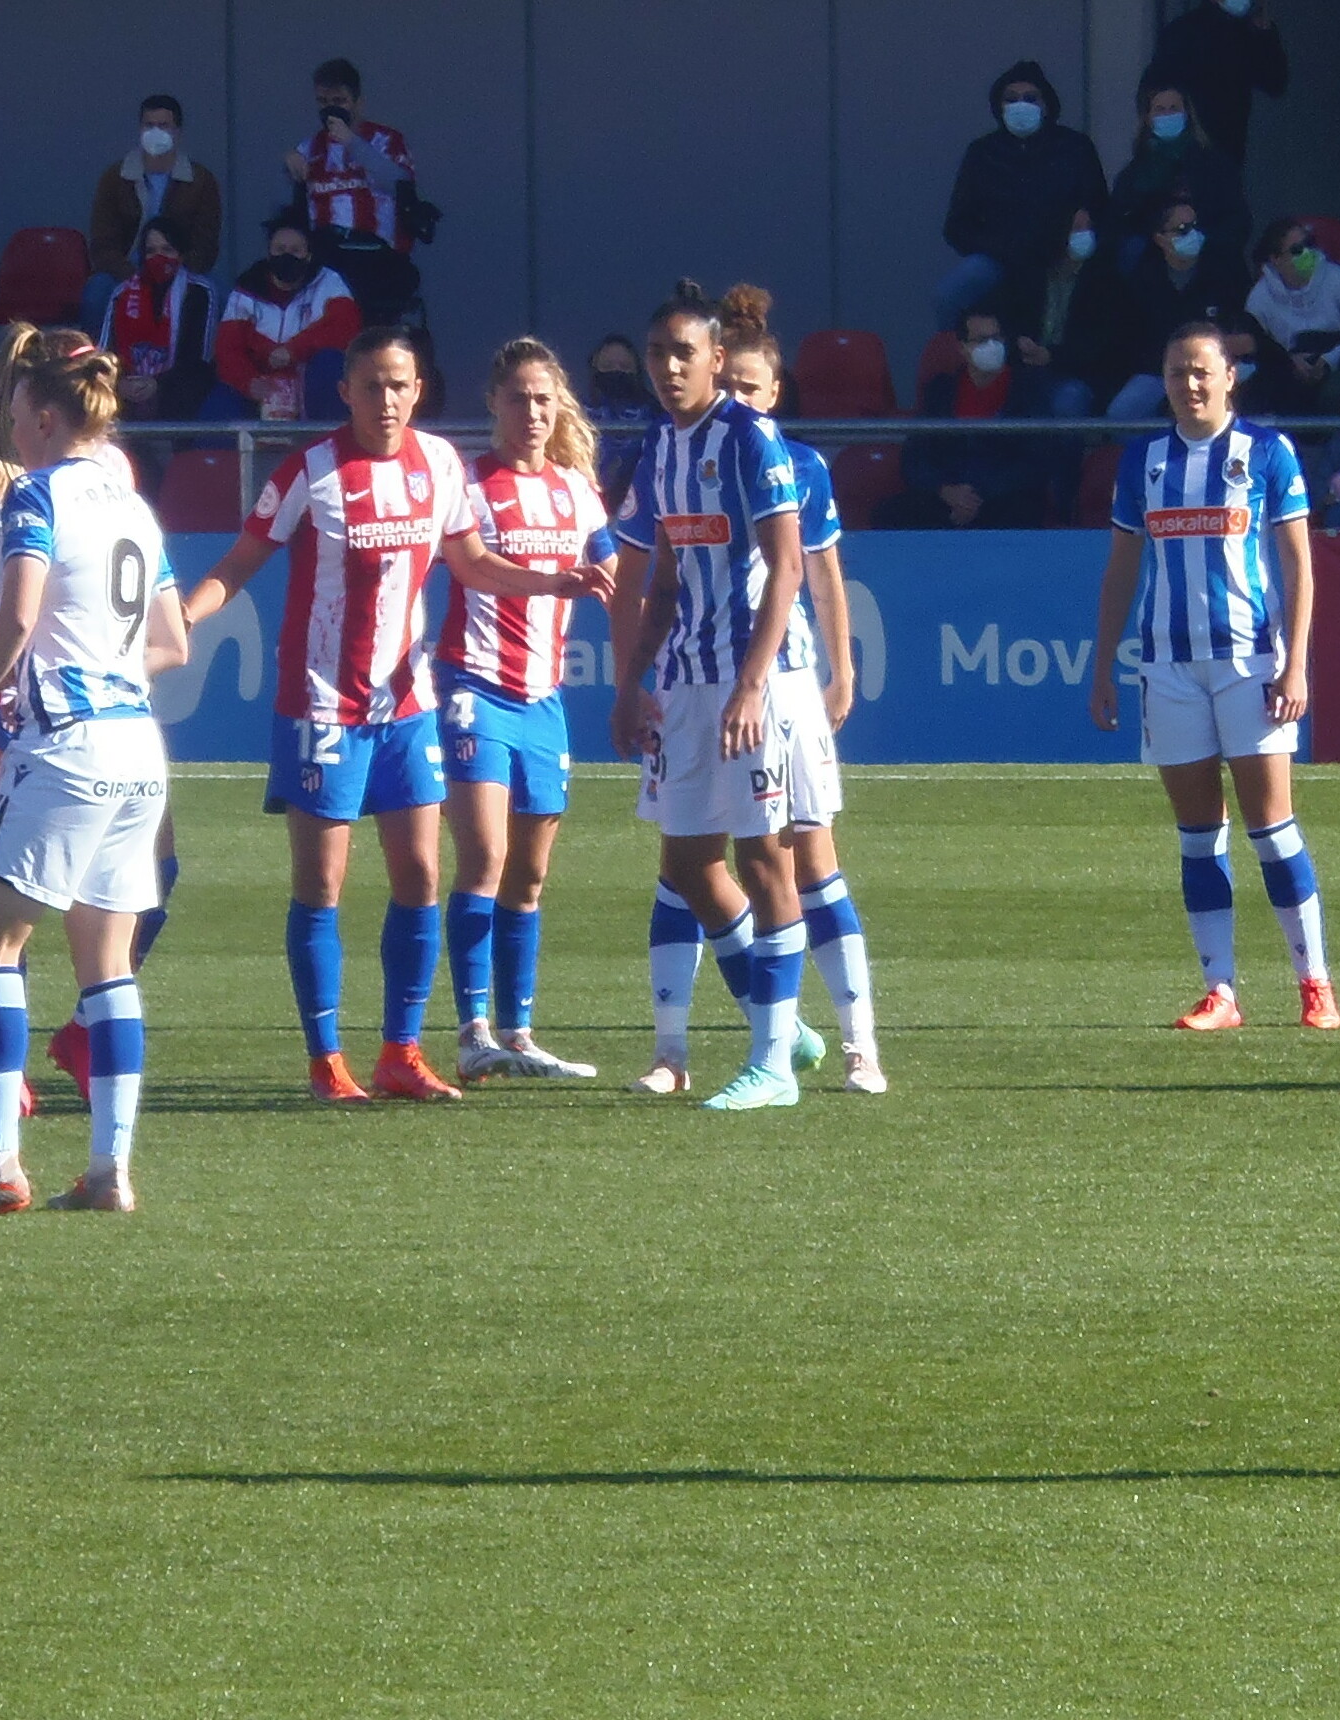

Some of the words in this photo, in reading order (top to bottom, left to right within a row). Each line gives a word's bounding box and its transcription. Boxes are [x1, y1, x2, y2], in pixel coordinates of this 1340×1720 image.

[348, 517, 434, 536] HERBALIFE
[500, 529, 579, 545] HERBALIFE
[348, 532, 434, 550] NUTRITION
[106, 537, 146, 660] 9
[940, 623, 1142, 687] Movs
[749, 764, 784, 794] DV
